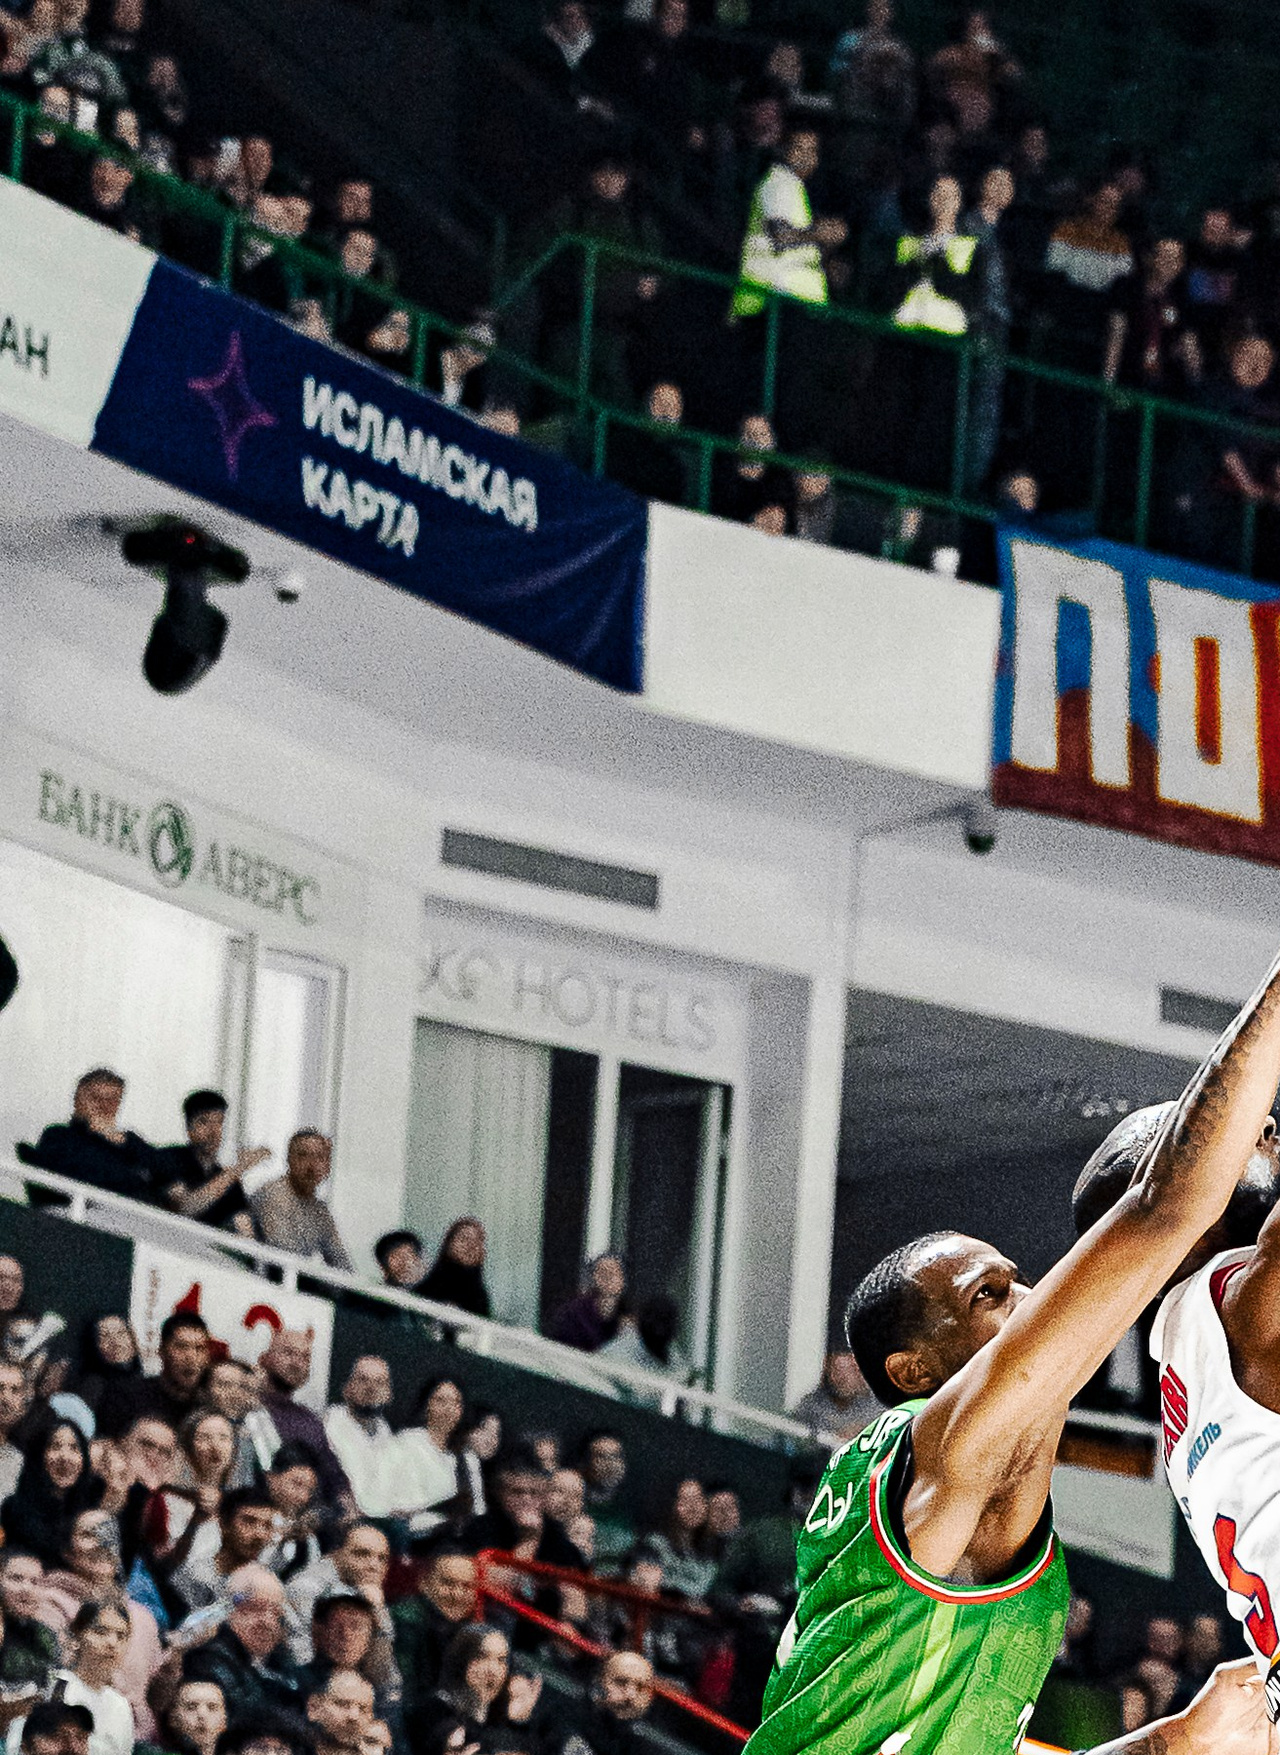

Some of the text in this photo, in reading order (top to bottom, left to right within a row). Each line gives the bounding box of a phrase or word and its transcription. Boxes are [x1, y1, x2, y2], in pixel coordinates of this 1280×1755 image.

[301, 455, 420, 557] КАРТА
[302, 374, 539, 533] ИСЛАМСКАЯ
[38, 766, 322, 928] БАНК АВЕРС
[510, 955, 718, 1053] HOTELS
